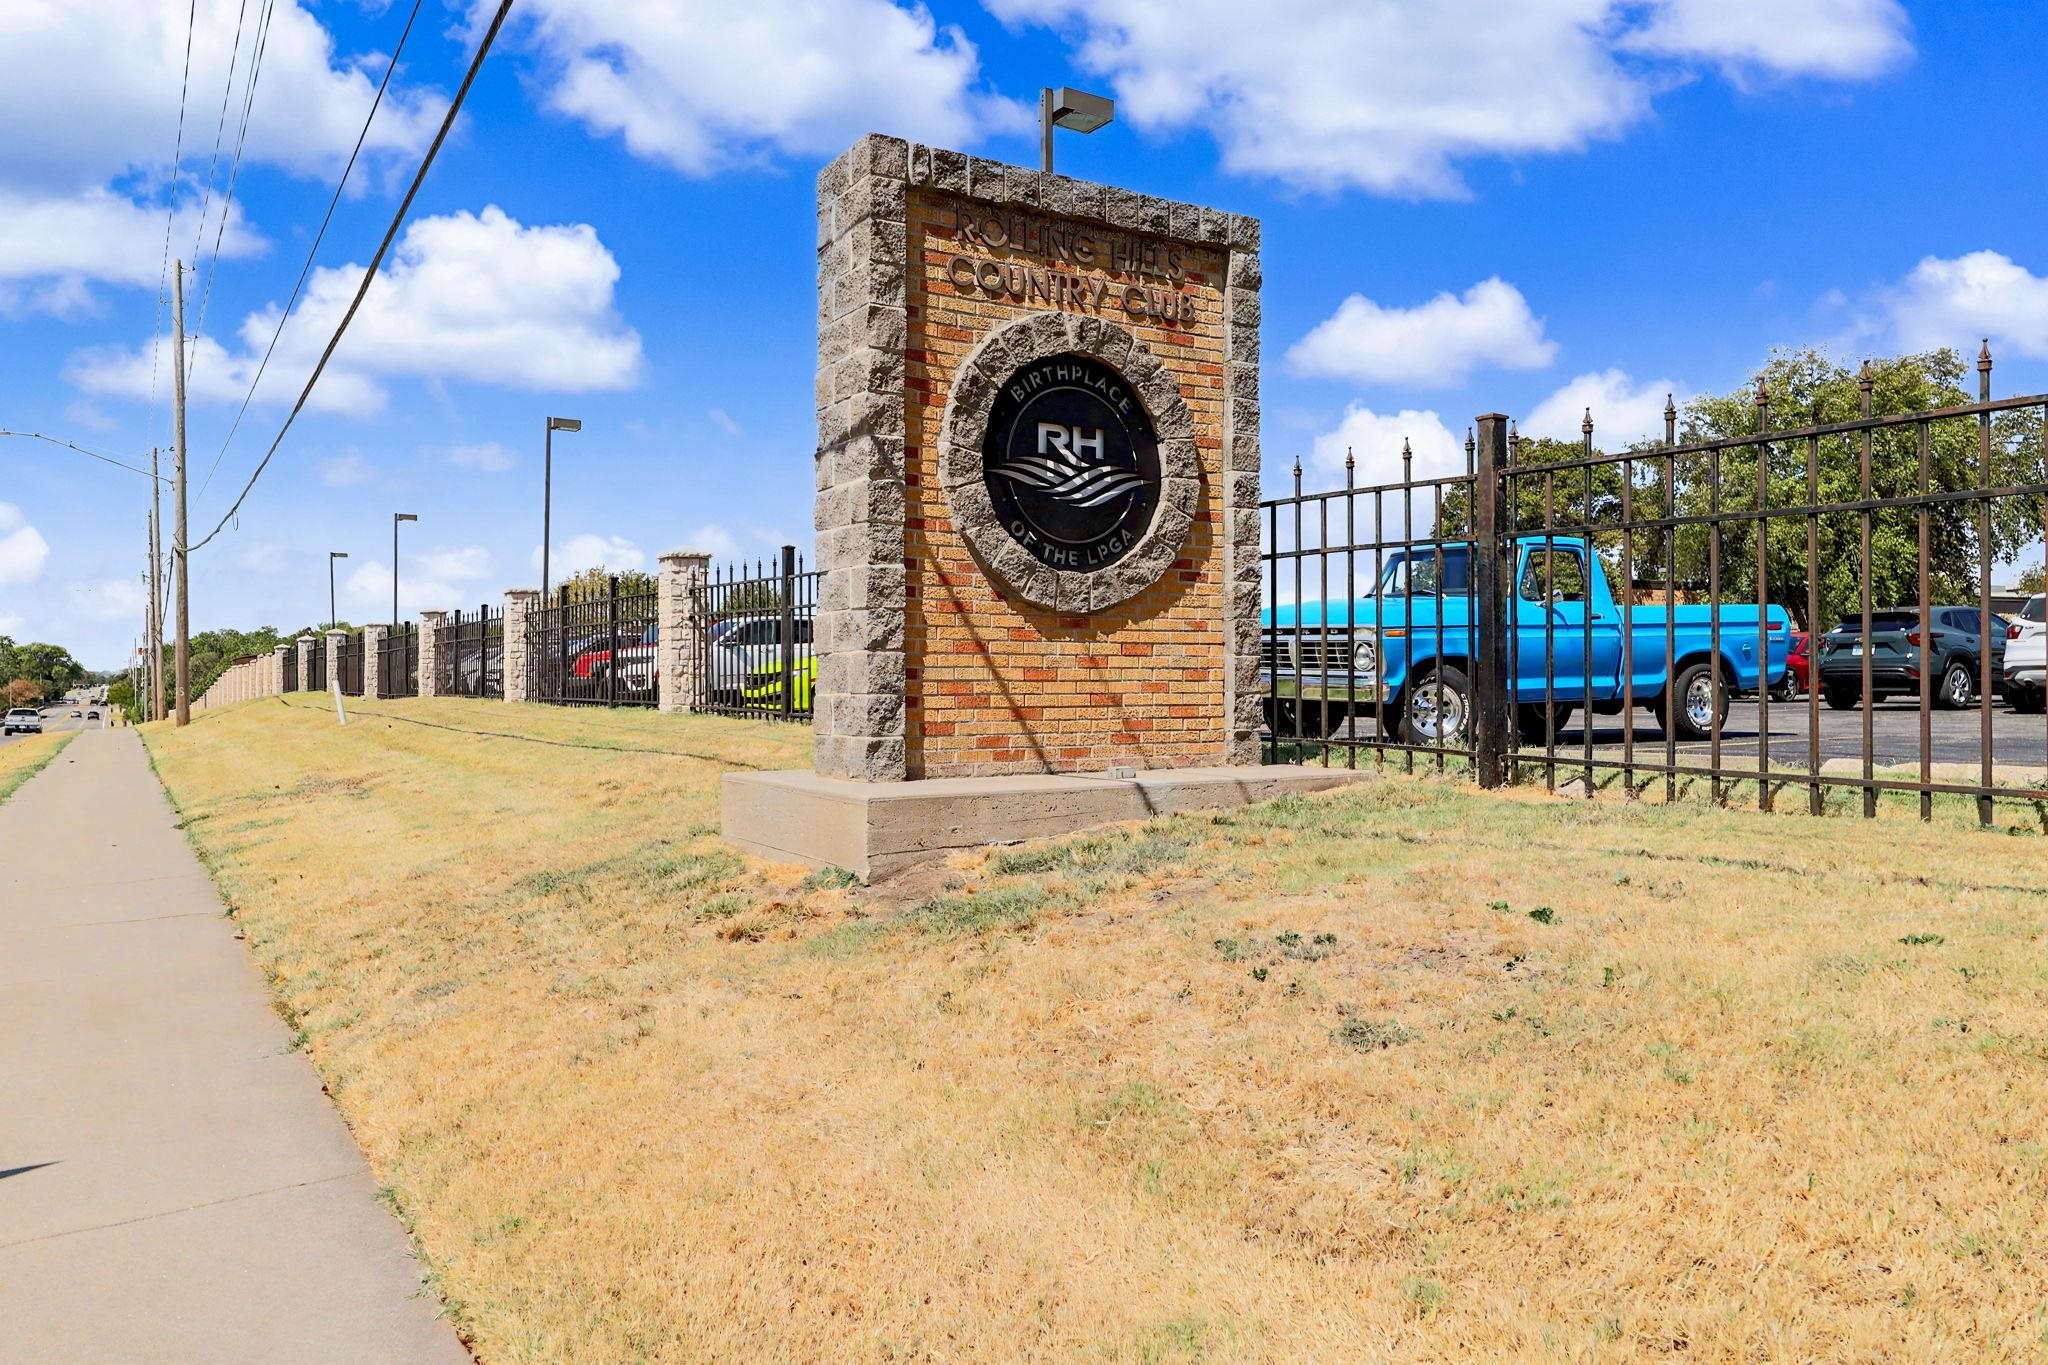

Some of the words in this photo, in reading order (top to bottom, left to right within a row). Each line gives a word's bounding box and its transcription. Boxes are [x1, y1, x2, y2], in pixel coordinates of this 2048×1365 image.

[956, 206, 1095, 262] ROLLING
[1111, 237, 1185, 280] HILLS
[947, 254, 1106, 308] COUNTRY
[1120, 283, 1195, 322] CLUB
[1010, 364, 1133, 415] BIRTHPLACE
[1037, 422, 1105, 466] RH
[1010, 520, 1038, 549] OF
[1042, 543, 1079, 566] THE
[1087, 529, 1135, 565] LPGA
